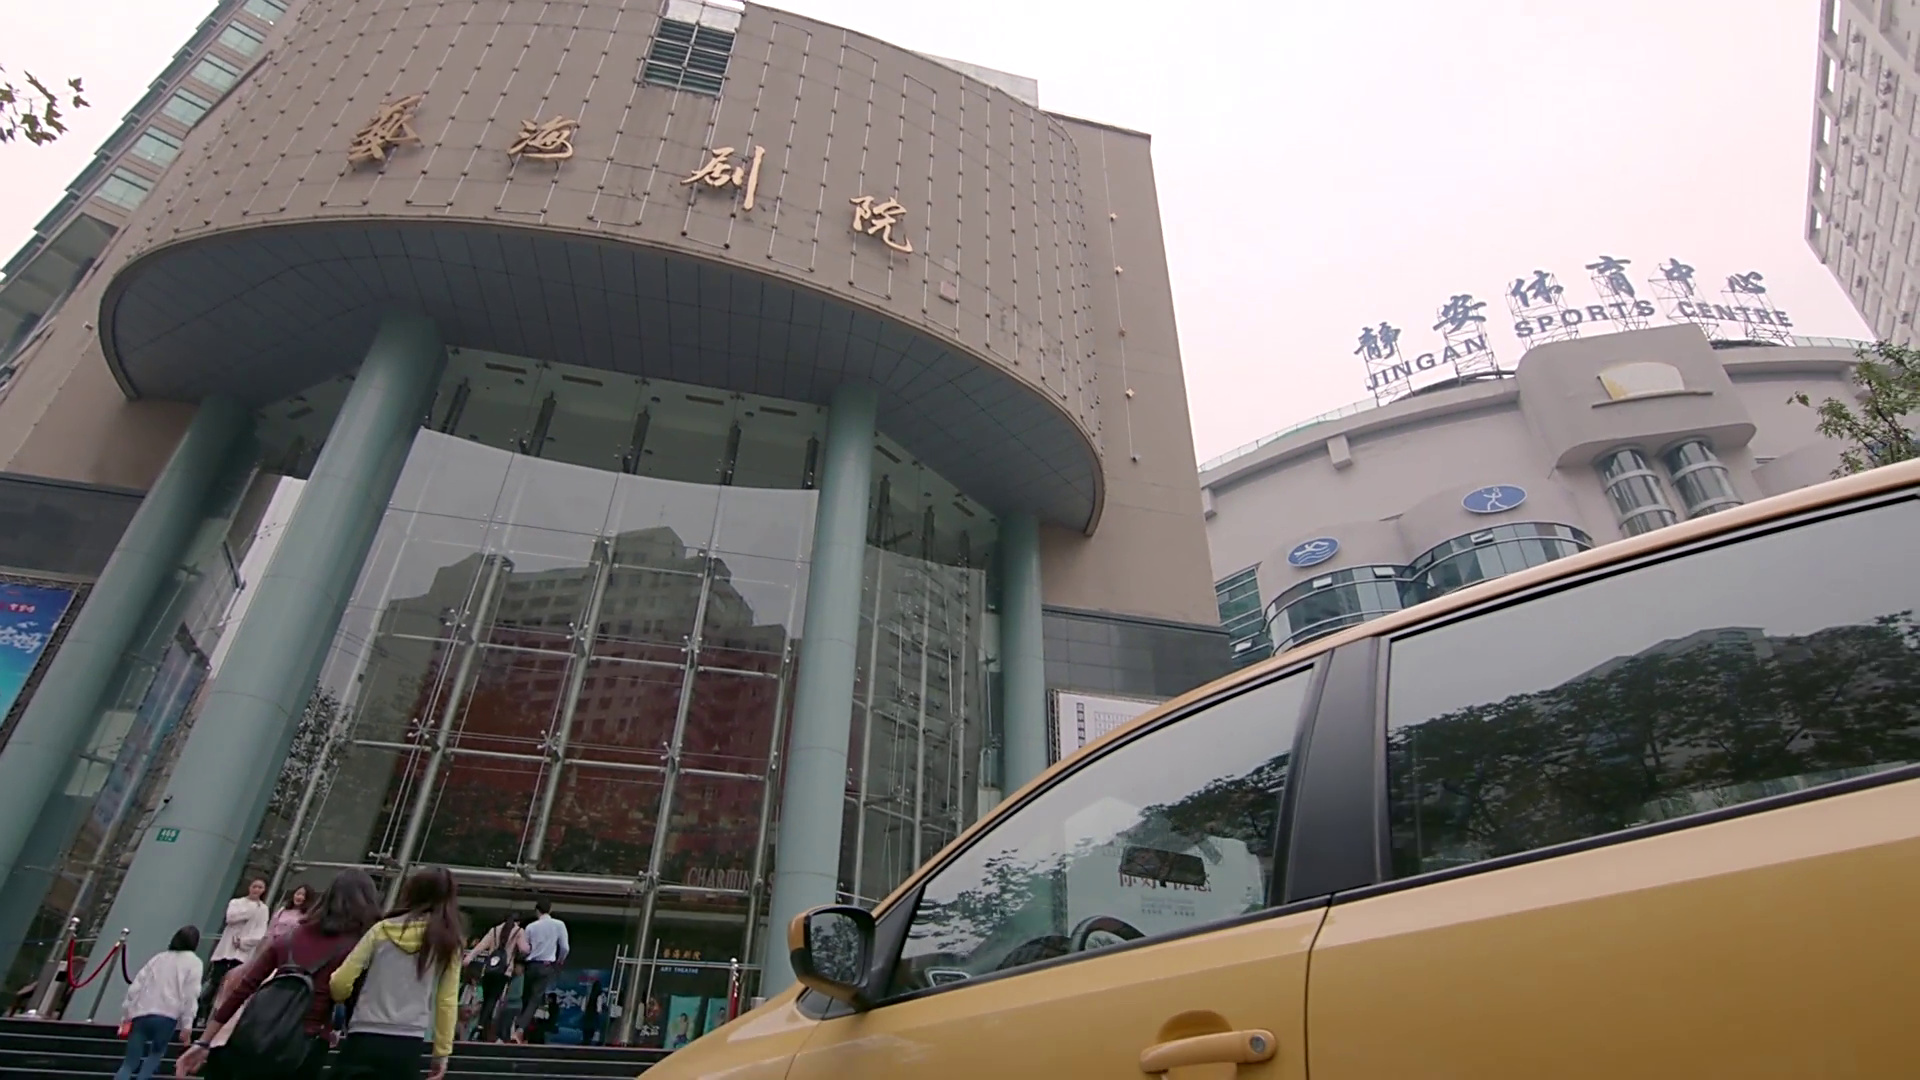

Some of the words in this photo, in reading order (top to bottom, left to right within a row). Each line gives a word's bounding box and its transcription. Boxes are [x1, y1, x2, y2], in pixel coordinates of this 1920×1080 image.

[1366, 334, 1487, 391] JINGAN
[1514, 300, 1656, 338] SPORTS
[1678, 301, 1793, 328] CENTRE
[687, 867, 754, 891] CHARMIN
